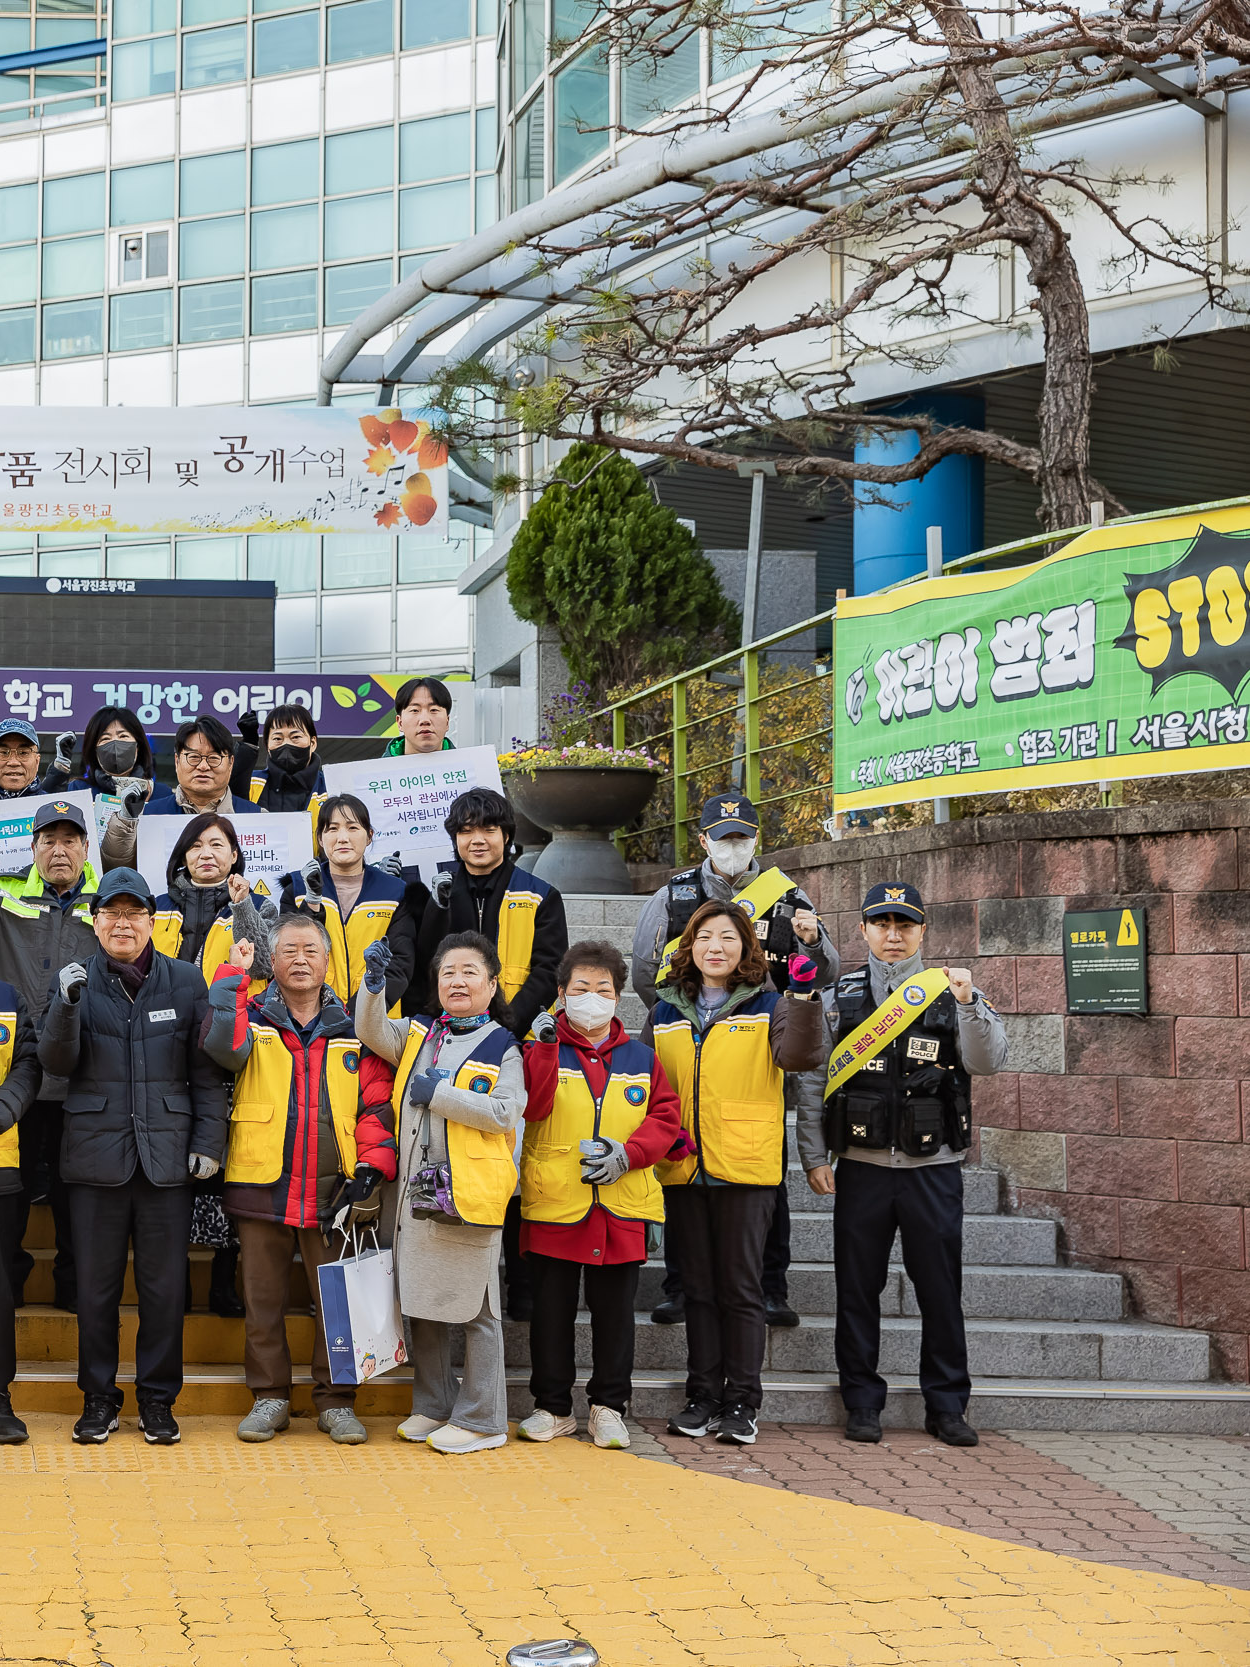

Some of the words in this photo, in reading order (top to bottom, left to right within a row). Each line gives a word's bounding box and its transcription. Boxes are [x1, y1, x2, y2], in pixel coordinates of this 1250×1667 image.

[53, 446, 151, 489] 전시회
[175, 459, 199, 487] 및
[213, 436, 344, 483] 공개수업
[62, 579, 136, 592] 서울광진초등학교
[874, 626, 982, 726] 어린이
[989, 599, 1096, 704] 범죄
[1134, 561, 1250, 669] STO
[3, 679, 73, 722] 학교
[1018, 730, 1056, 765] 협조
[1059, 722, 1099, 758] 기관
[1130, 703, 1249, 749] 서울시청
[368, 779, 392, 793] 우리
[399, 773, 436, 789] 아이의
[442, 769, 468, 784] 안전
[383, 795, 413, 808] 모두의
[872, 1005, 906, 1036] 주민과
[852, 1033, 876, 1055] 함께
